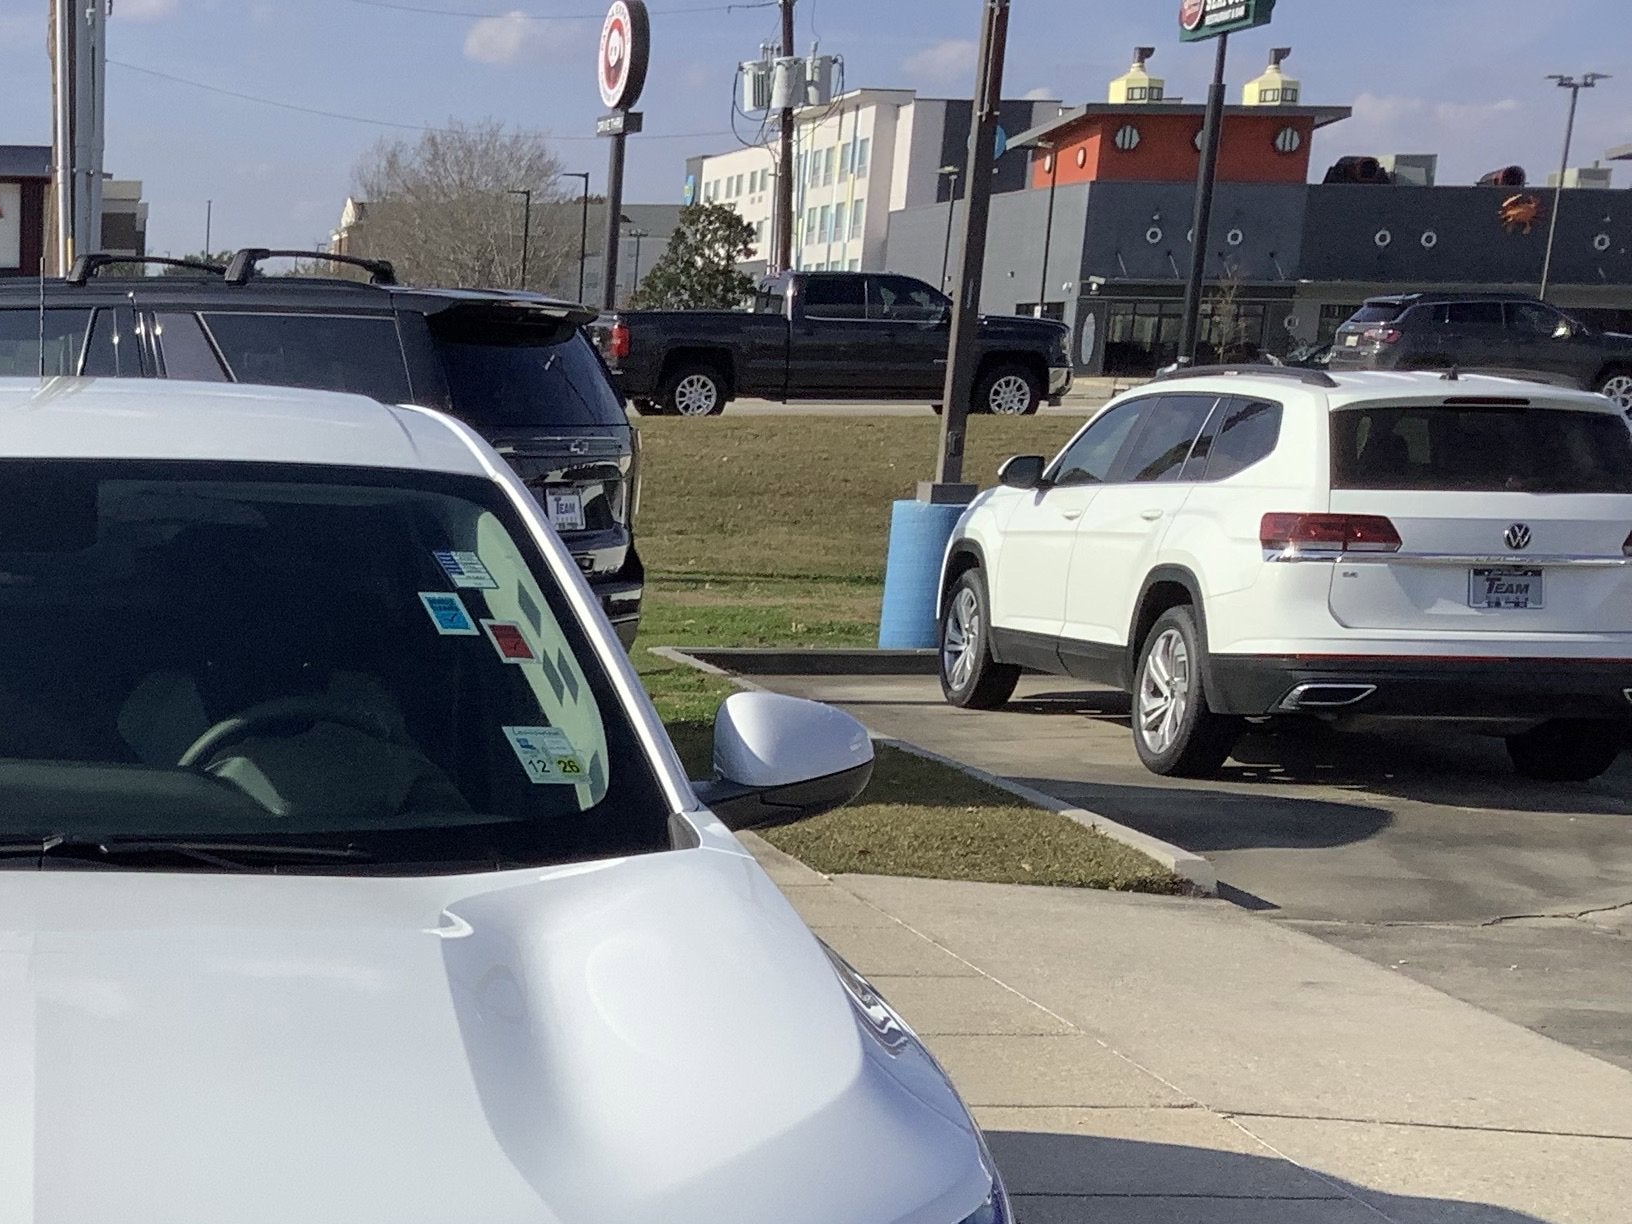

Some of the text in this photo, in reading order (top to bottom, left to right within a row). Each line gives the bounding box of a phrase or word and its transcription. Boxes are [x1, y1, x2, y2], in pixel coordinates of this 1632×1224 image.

[1485, 576, 1530, 595] TEAM
[528, 759, 580, 773] 12 26
